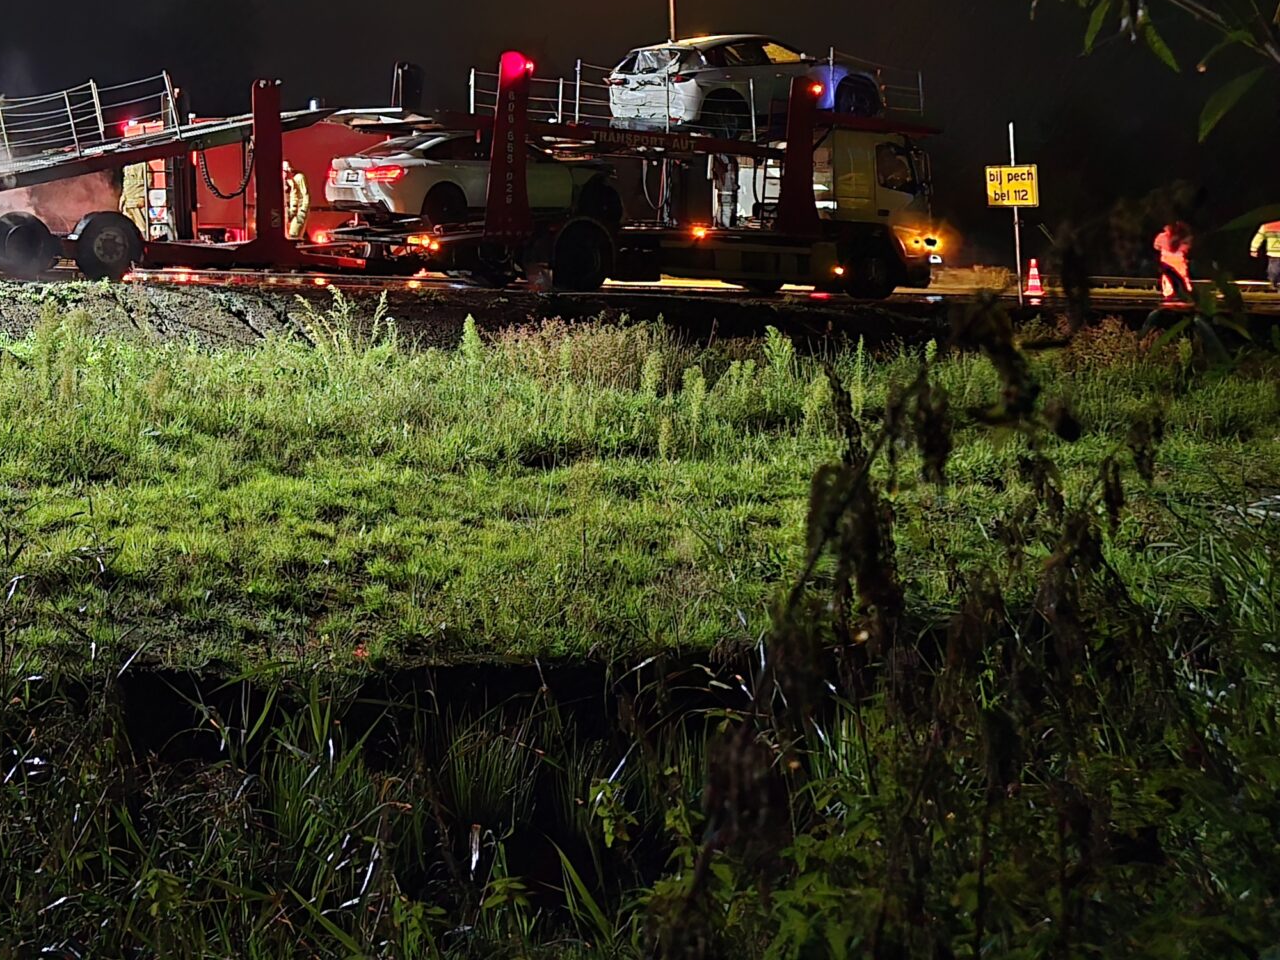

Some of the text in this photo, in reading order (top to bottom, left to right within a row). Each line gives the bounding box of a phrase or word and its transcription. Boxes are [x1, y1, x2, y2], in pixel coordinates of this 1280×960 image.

[592, 130, 665, 147] TRANSPORT
[989, 170, 1034, 185] bij pech
[994, 189, 1028, 201] bel 112
